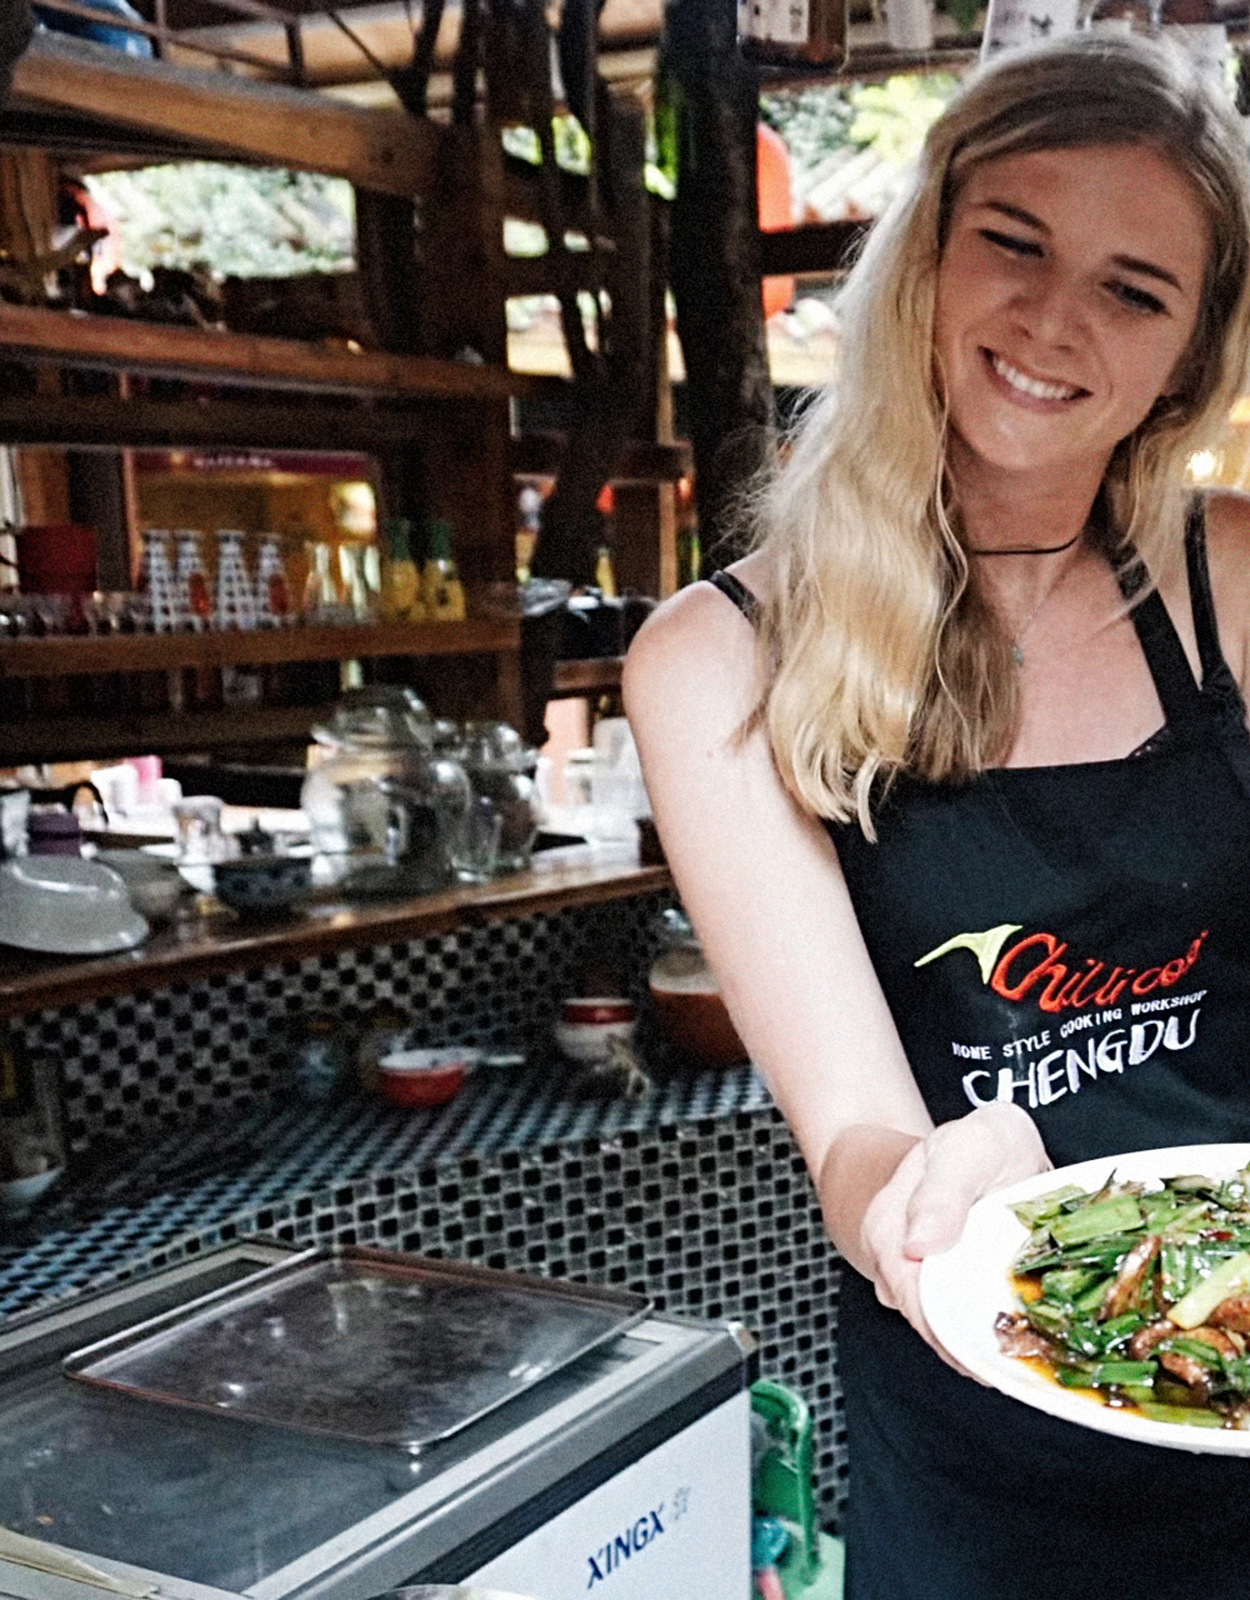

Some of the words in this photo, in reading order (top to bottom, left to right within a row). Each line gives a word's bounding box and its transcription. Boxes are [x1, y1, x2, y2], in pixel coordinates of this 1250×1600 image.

[951, 1041, 993, 1061] HOME
[1002, 1029, 1051, 1058] STYLE
[1060, 1007, 1123, 1039] COOKING
[1131, 989, 1208, 1016] WORKSHOP
[962, 1008, 1201, 1109] CHENGDU
[587, 1501, 664, 1590] XINGX
